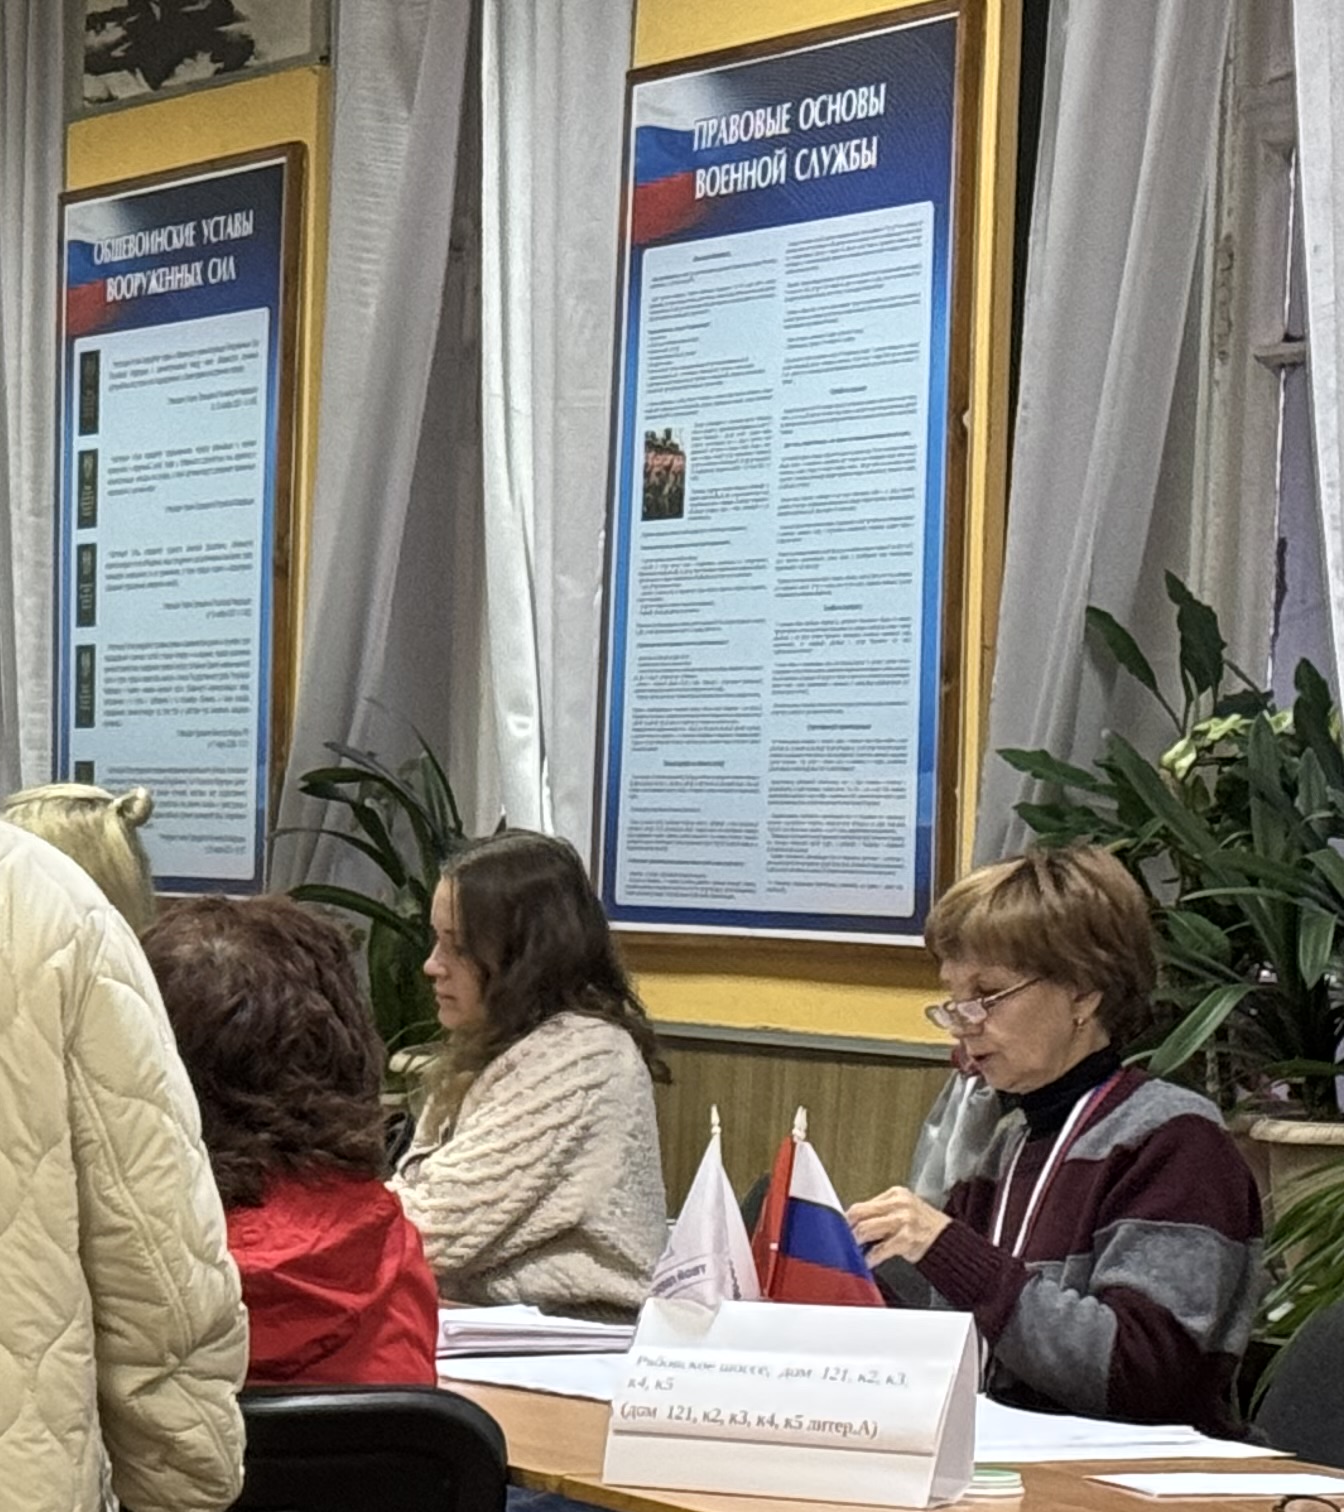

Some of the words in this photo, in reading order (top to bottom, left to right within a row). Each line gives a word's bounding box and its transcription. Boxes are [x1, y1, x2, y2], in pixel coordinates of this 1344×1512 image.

[693, 102, 793, 151] ПРАВОВЫЕ
[799, 83, 887, 131] ОСНОВЫ
[694, 146, 788, 200] ВОЕННОЙ
[794, 135, 878, 182] СЛУЖБЫ
[93, 221, 198, 266] ОБЩЕВОИНСКИЕ
[201, 209, 255, 246] УСТАВЫ
[106, 260, 205, 303] ВООРУЖЕННЫХ
[207, 254, 237, 285] СИЛ
[666, 1404, 698, 1424] 121,
[702, 1407, 725, 1426] к2,
[728, 1410, 752, 1428] к3,
[755, 1412, 780, 1430] к4,
[783, 1414, 805, 1430] к5
